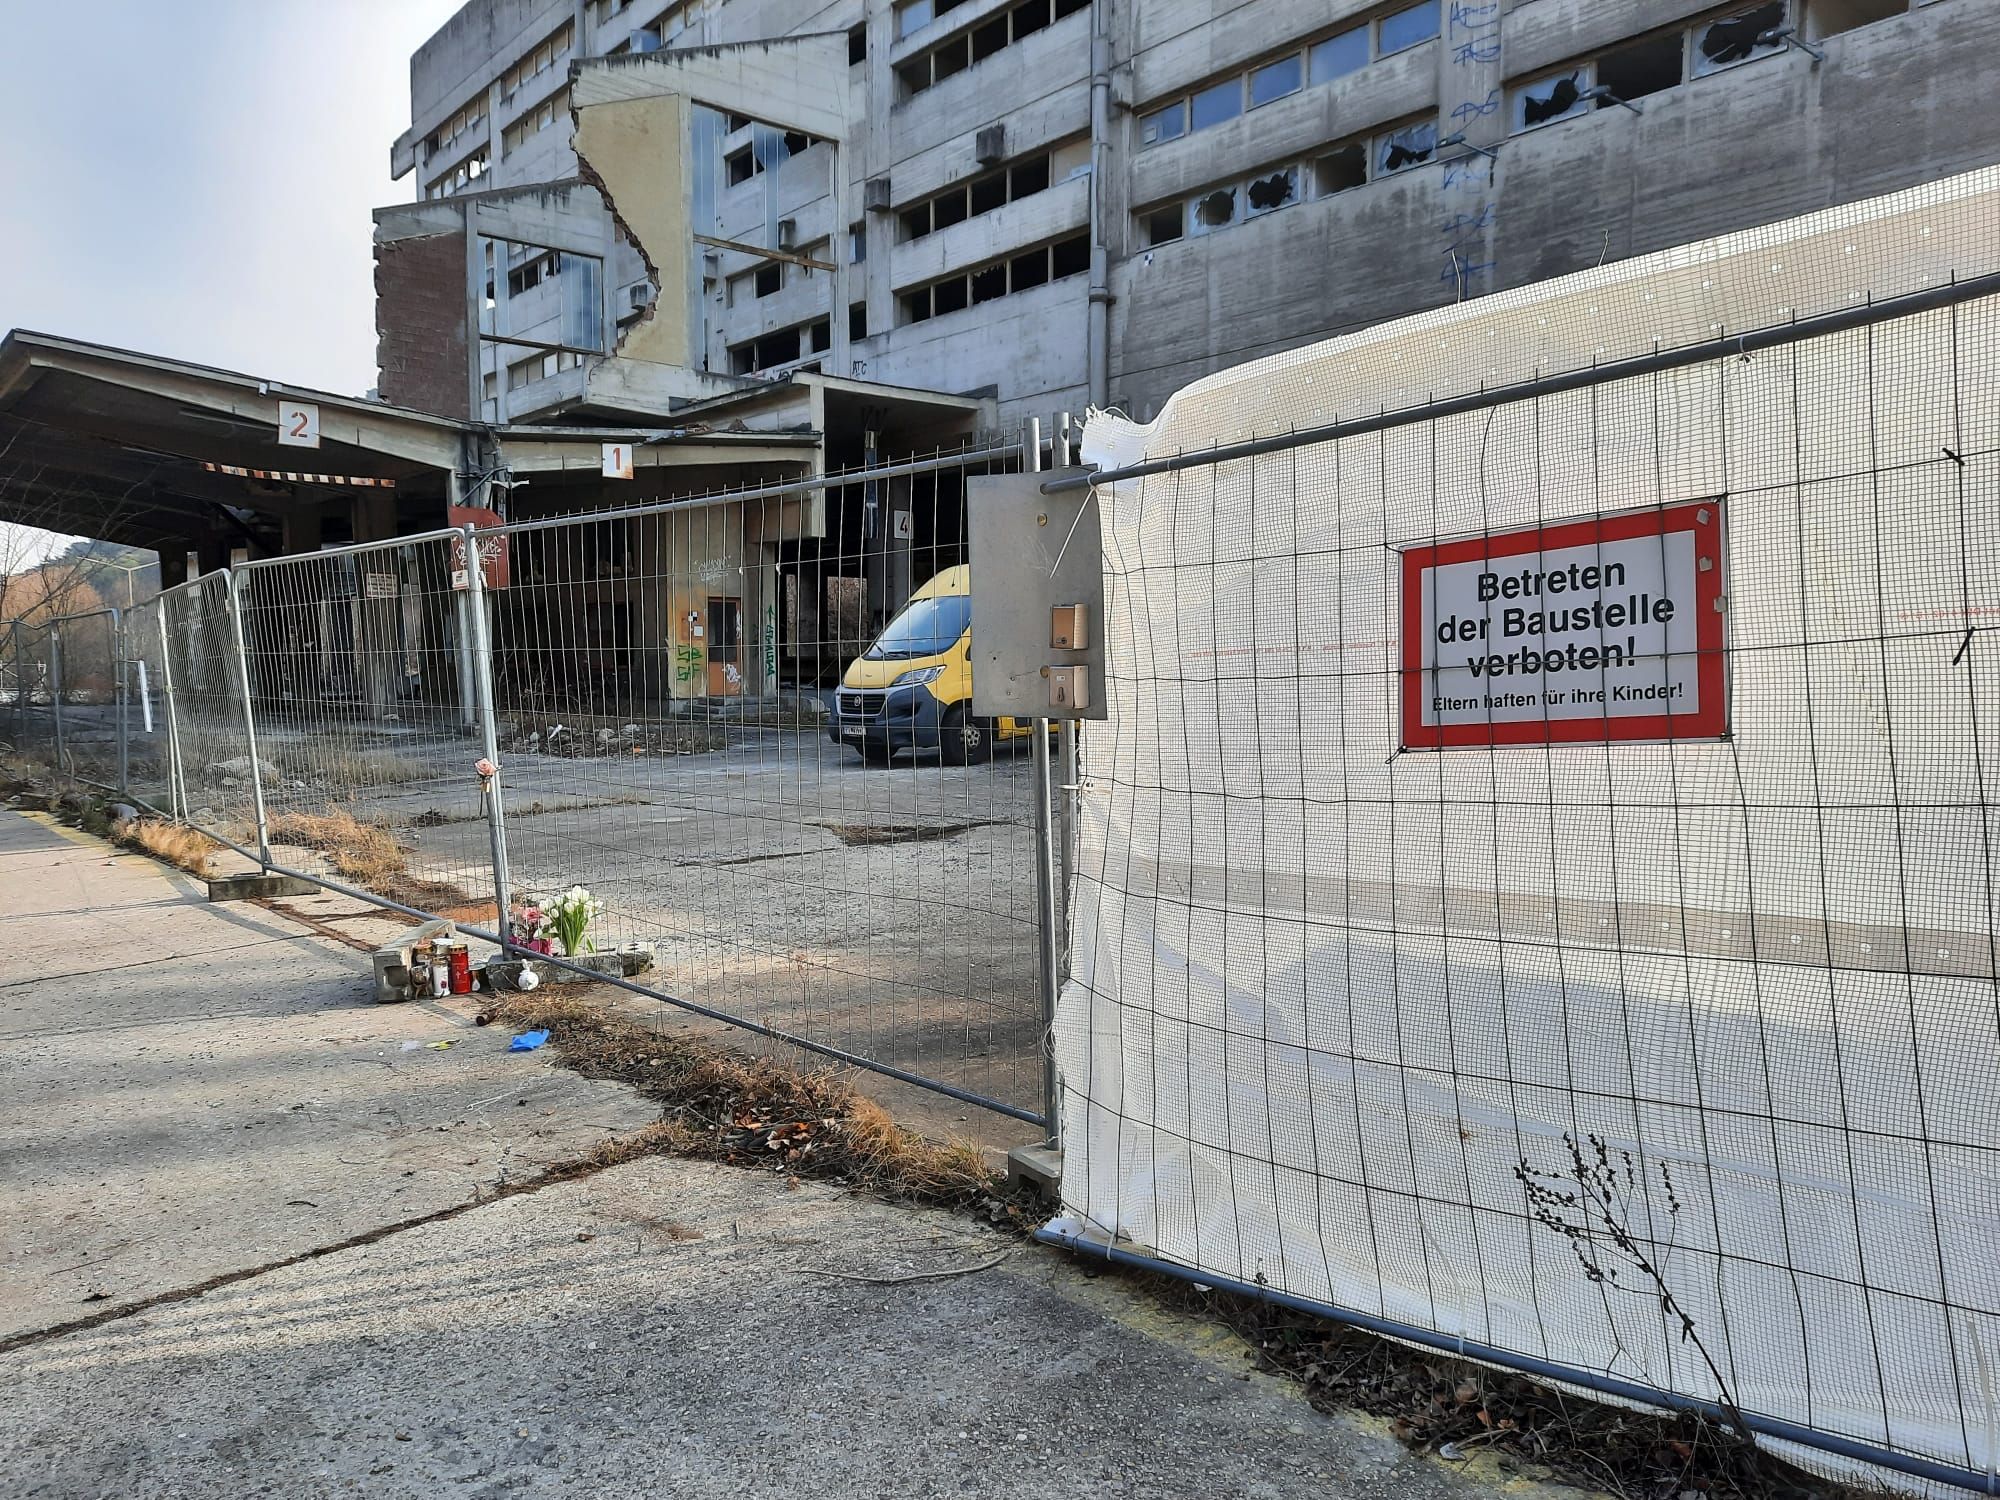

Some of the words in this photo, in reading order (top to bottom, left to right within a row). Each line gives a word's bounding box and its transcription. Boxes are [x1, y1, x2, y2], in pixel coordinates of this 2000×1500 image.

[290, 411, 308, 438] 2
[612, 447, 621, 470] 1
[899, 516, 908, 534] 4
[1478, 562, 1625, 602] Betreten
[1438, 613, 1491, 644] der
[1503, 593, 1675, 638] Baustelle
[1467, 636, 1636, 678] verboten!
[1433, 695, 1478, 712] Eltern
[1484, 691, 1536, 709] haften
[1542, 688, 1565, 706] für
[1572, 687, 1606, 704] ihre
[1613, 682, 1683, 701] Kinder!
